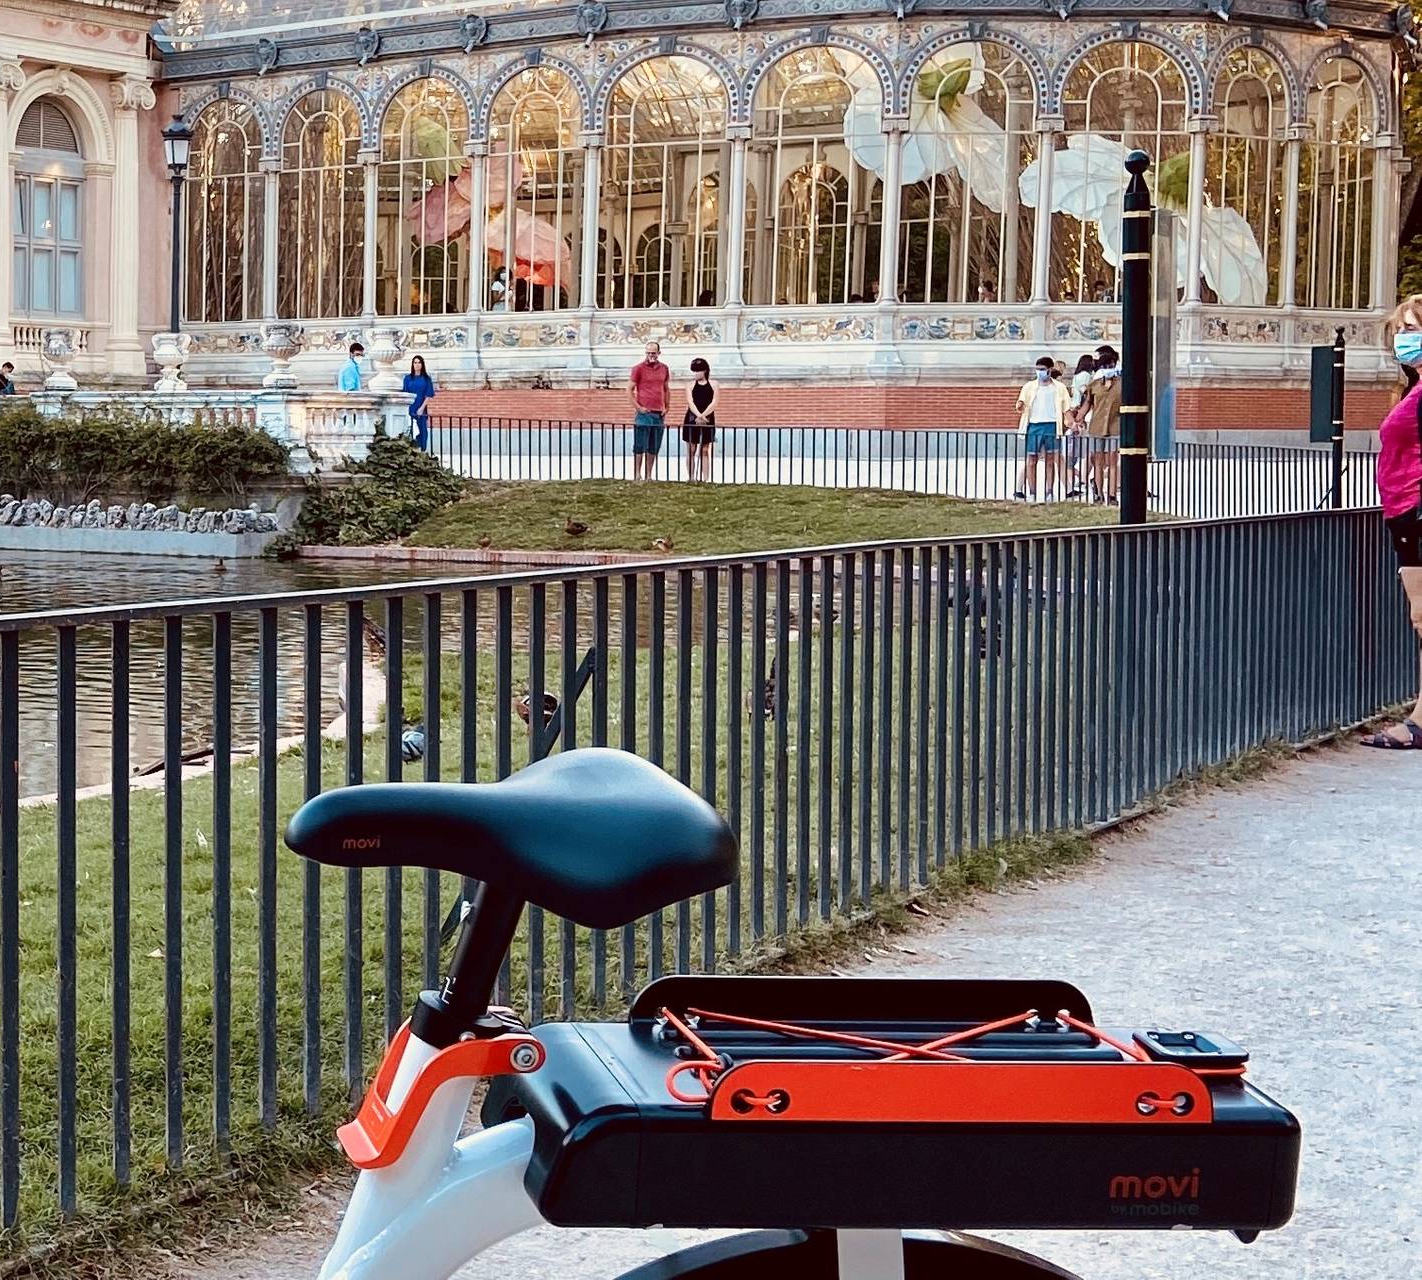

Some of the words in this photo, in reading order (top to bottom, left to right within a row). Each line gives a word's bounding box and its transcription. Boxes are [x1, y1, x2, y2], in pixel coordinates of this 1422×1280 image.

[343, 835, 381, 849] movi
[1109, 1168, 1200, 1198] movi
[1130, 1203, 1200, 1216] mobike
